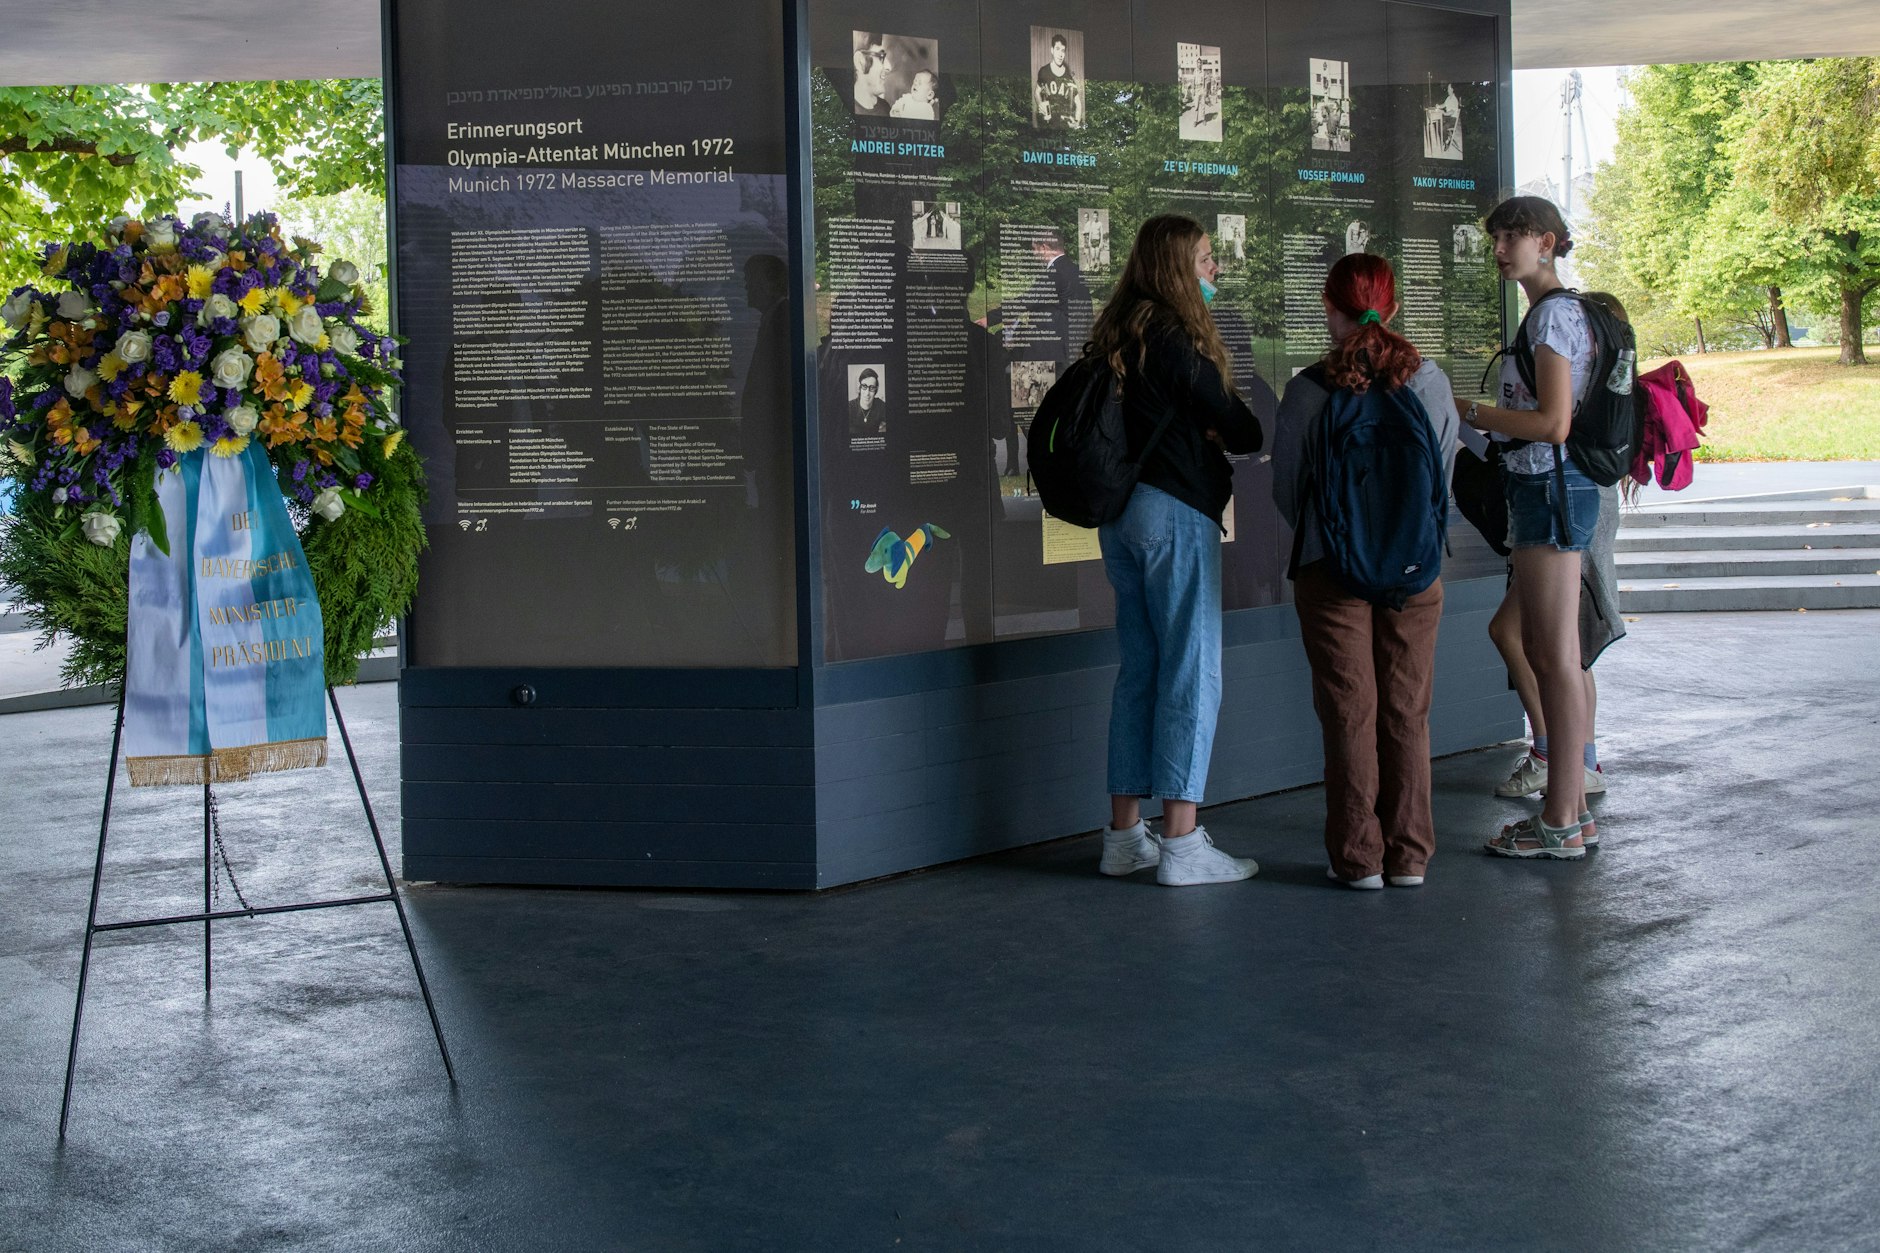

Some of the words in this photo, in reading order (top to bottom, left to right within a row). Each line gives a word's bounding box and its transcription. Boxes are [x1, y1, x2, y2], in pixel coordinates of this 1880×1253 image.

[586, 83, 632, 99] הפיגוע
[636, 80, 693, 96] קורבנות
[697, 77, 733, 92] לזכר
[446, 90, 483, 106] מינכן
[448, 118, 582, 140] Erinnerungsort
[448, 146, 598, 170] Olympia-Attentat
[604, 142, 686, 160] München
[691, 138, 734, 156] 1972
[851, 140, 895, 154] ANDREI
[898, 143, 945, 158] SPITZER
[1024, 151, 1053, 164] DAVID
[1057, 153, 1096, 167] BERGER
[1192, 162, 1238, 175] FRIEDMAN
[1298, 169, 1329, 180] YOSSEF
[1331, 172, 1365, 183] ROMANO
[449, 176, 510, 193] Munich
[517, 174, 556, 190] 1972
[562, 172, 644, 189] Massacre
[650, 166, 734, 185] Memorial
[1413, 177, 1437, 188] YAKOV
[1438, 178, 1475, 190] SPRINGER
[210, 597, 306, 625] MINISTER-
[212, 636, 312, 668] PRÄSIDENT
